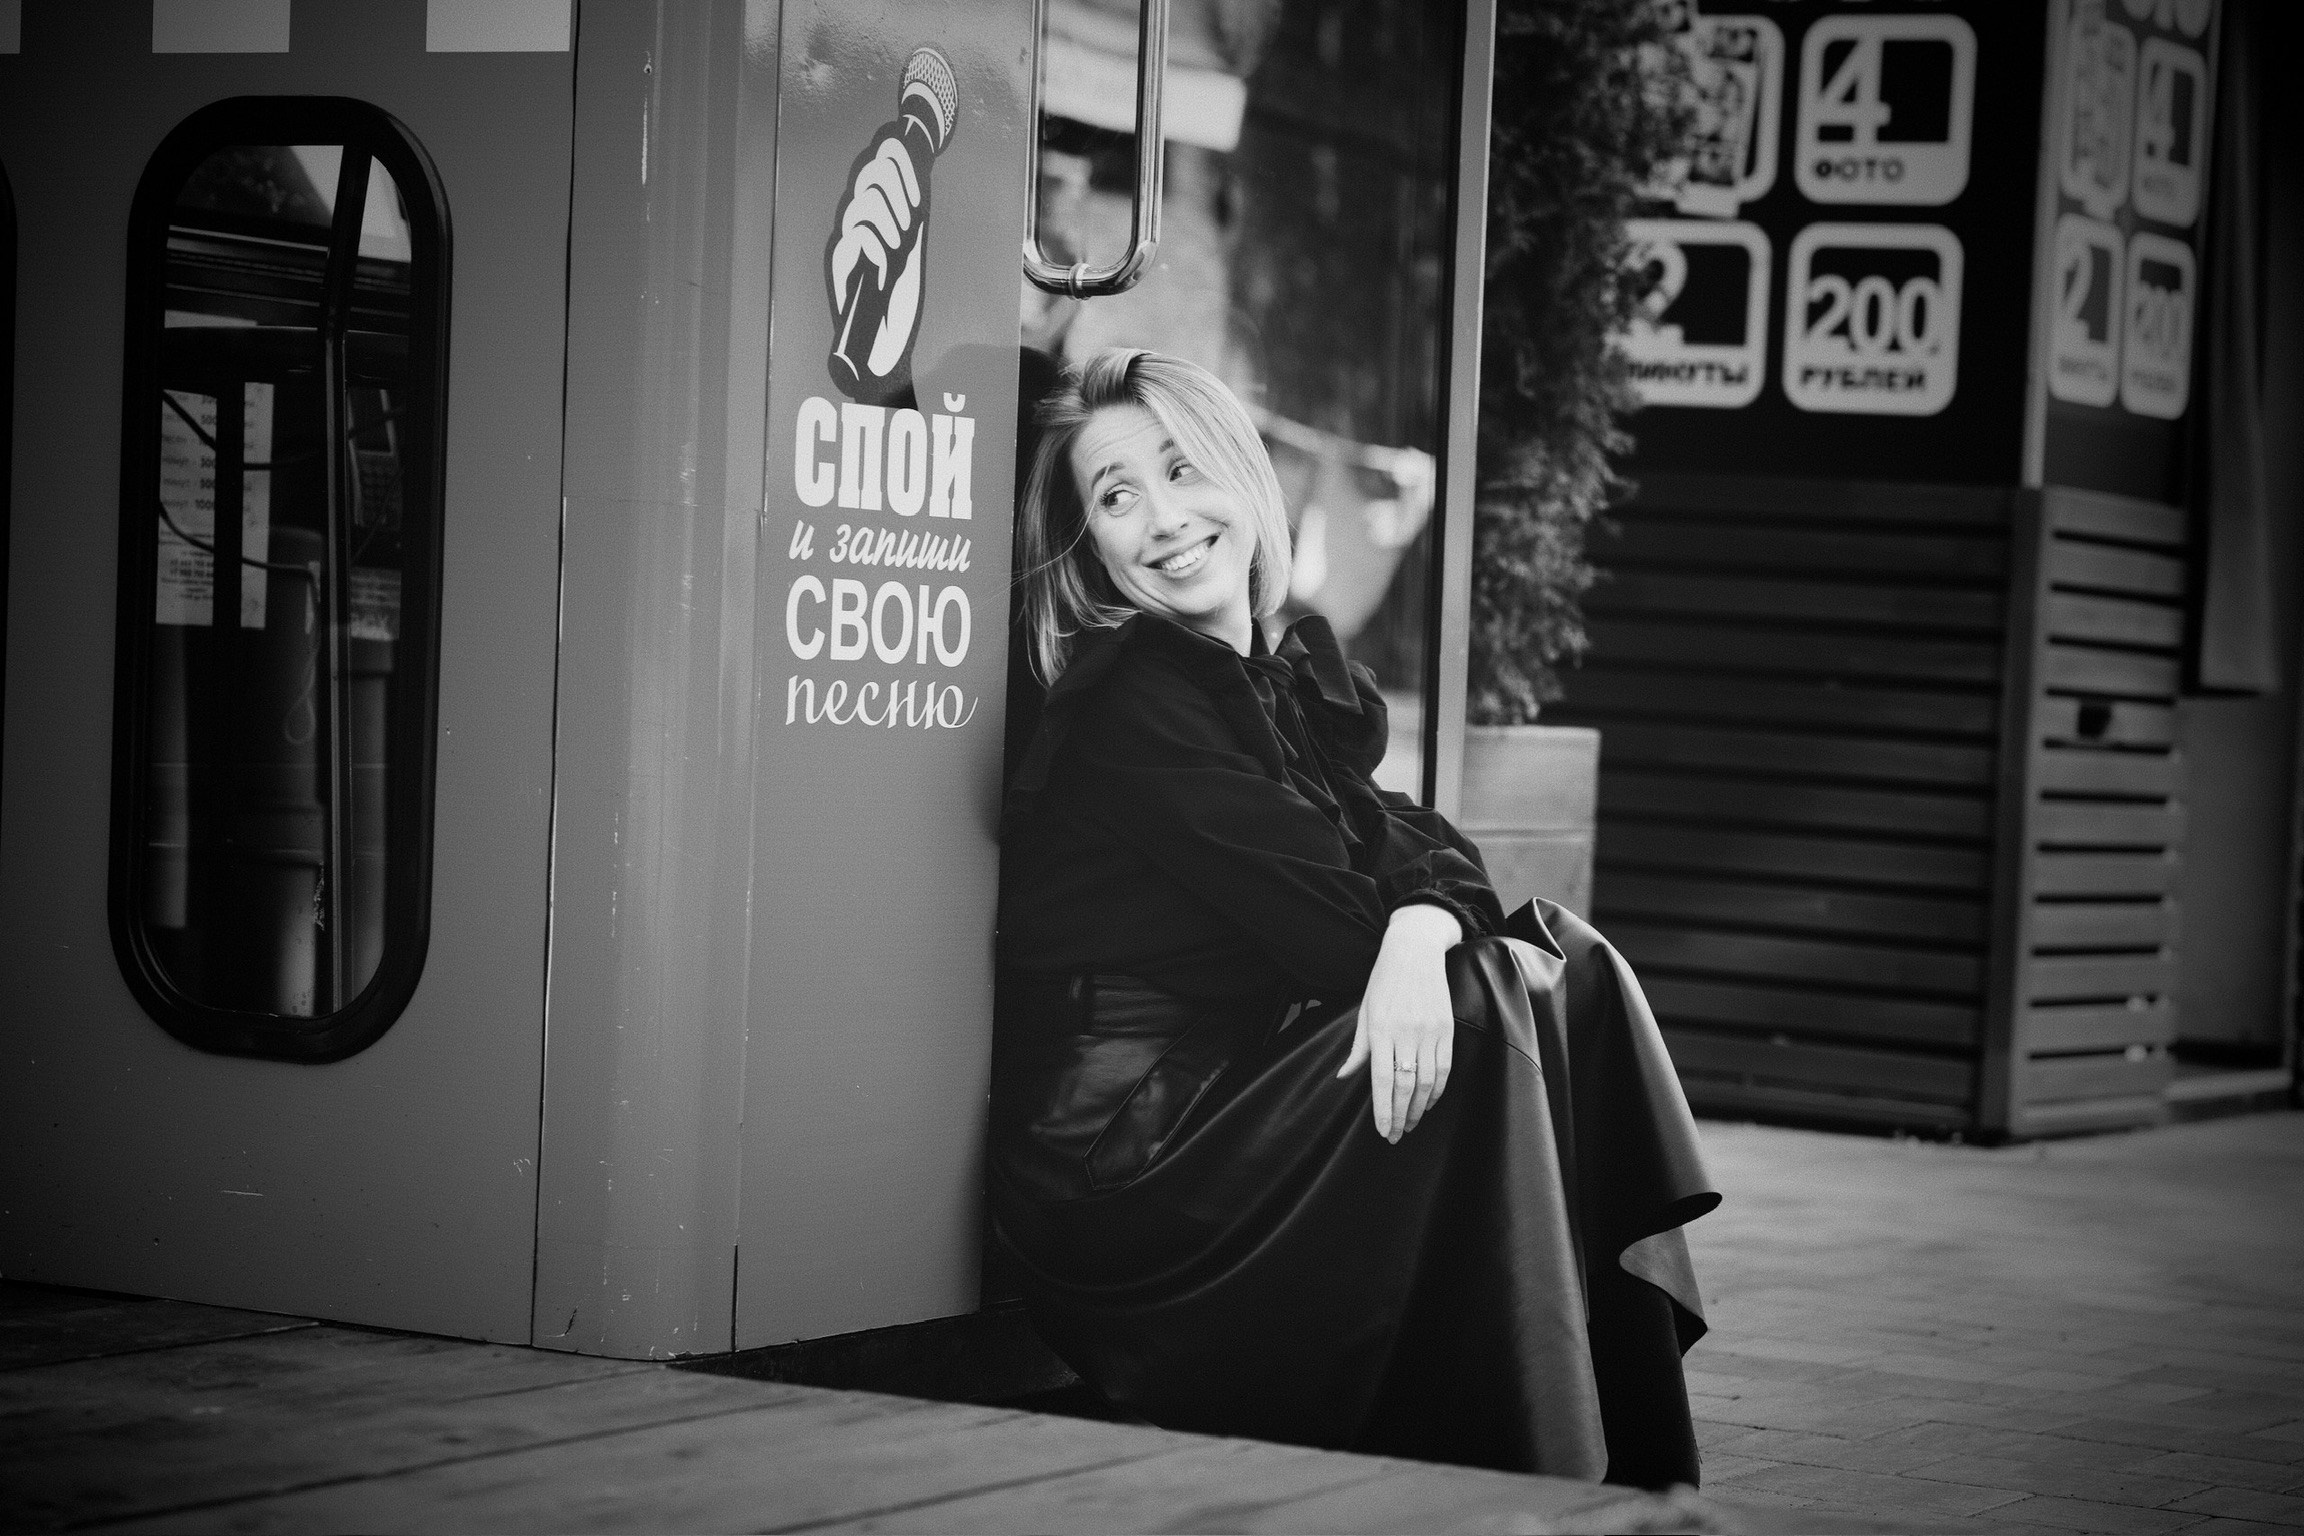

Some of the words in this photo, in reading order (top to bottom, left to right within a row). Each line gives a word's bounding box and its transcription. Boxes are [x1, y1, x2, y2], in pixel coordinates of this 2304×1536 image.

[1813, 32, 1892, 144] 4
[1807, 275, 1941, 354] 200
[794, 392, 975, 520] СПОЙ
[788, 519, 816, 561] и
[828, 523, 973, 574] запиши
[785, 574, 973, 668] СВОЮ
[785, 674, 979, 730] песню
